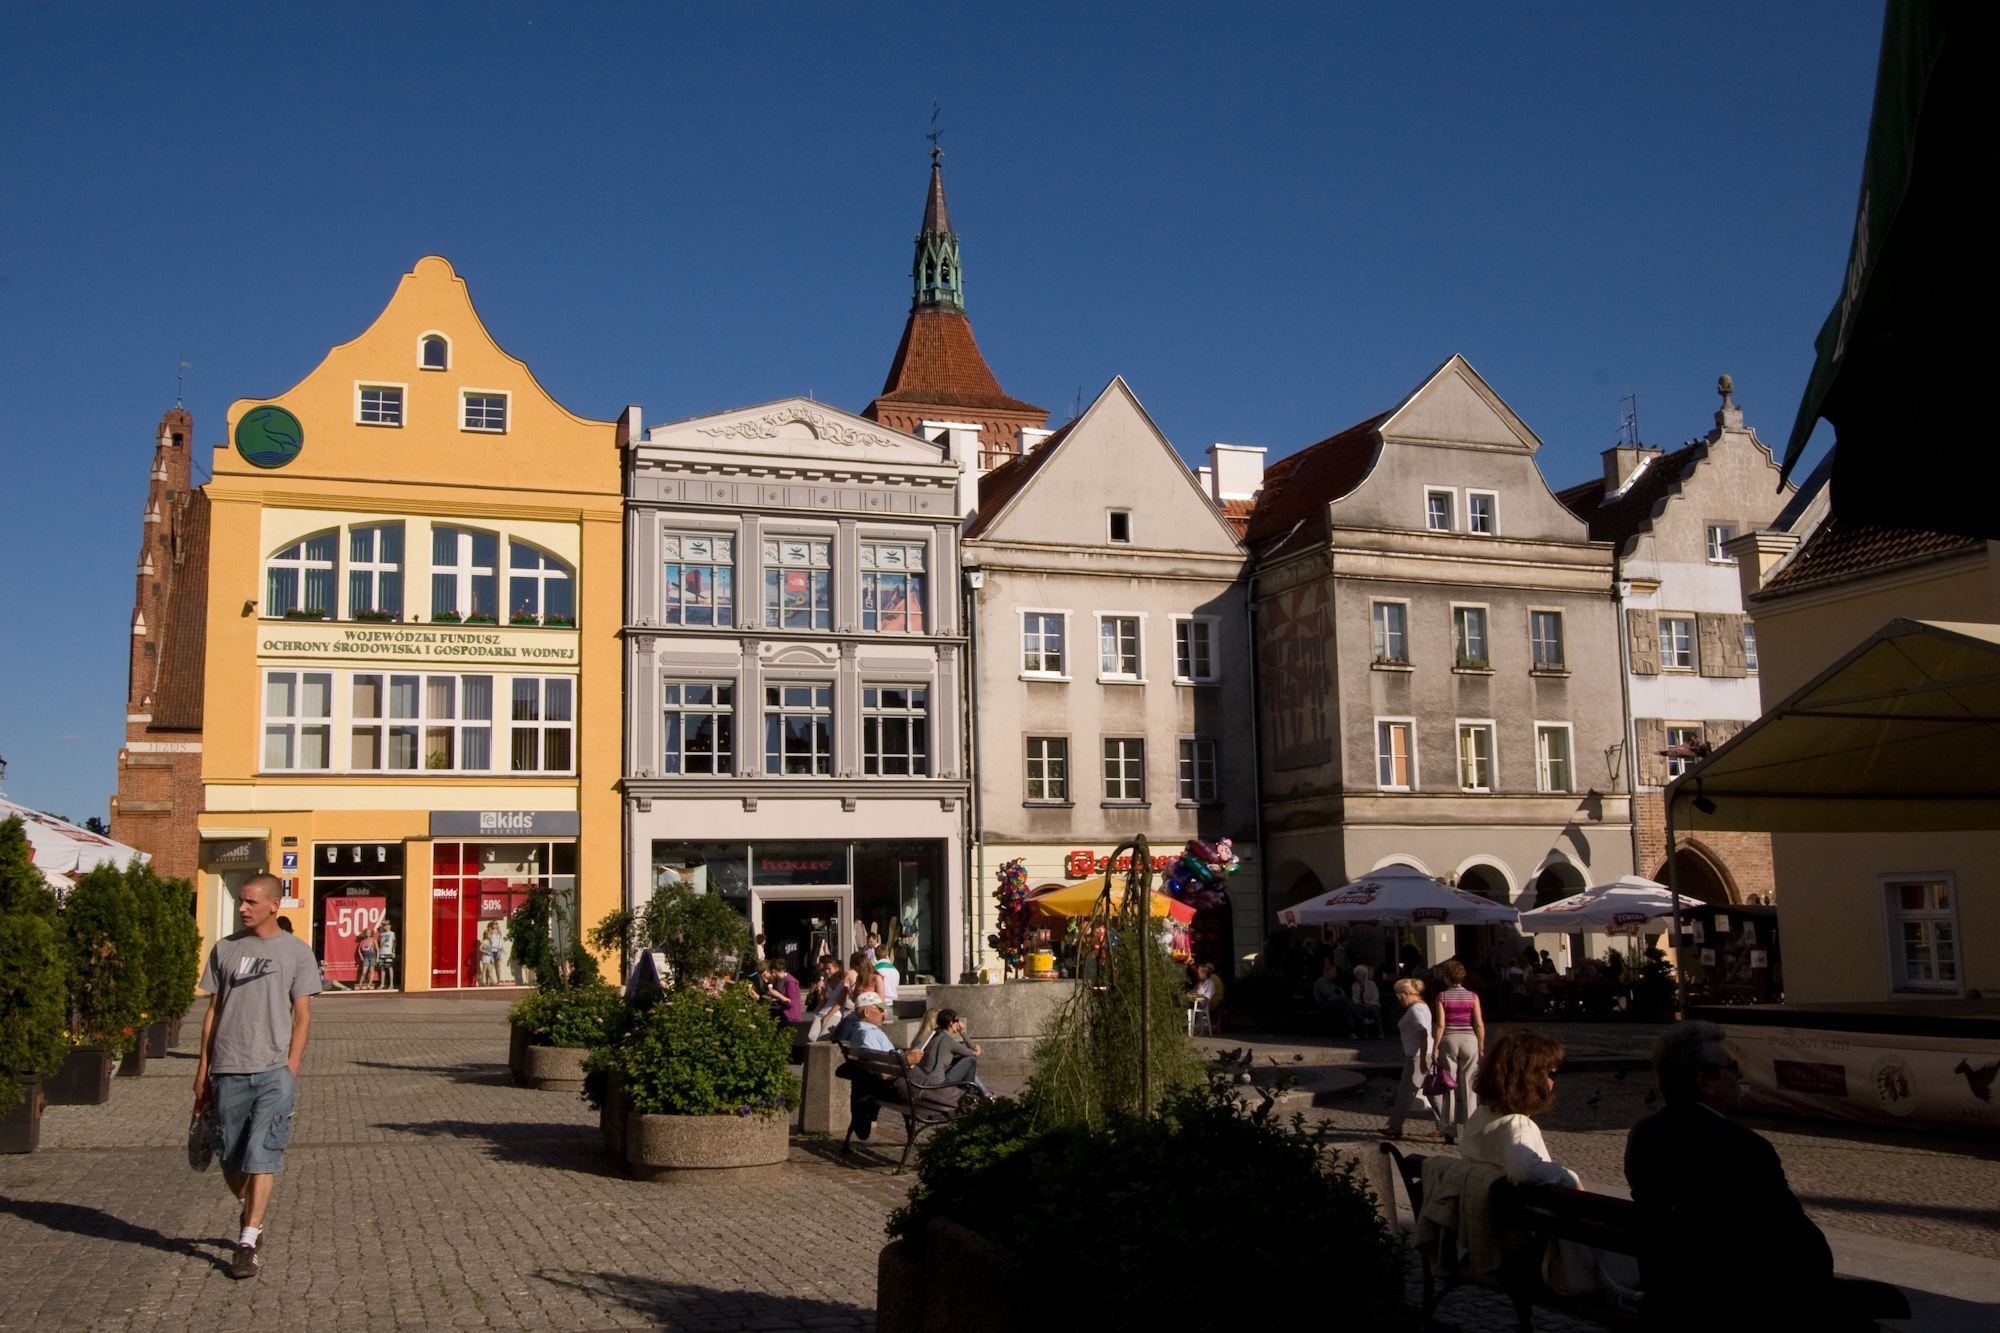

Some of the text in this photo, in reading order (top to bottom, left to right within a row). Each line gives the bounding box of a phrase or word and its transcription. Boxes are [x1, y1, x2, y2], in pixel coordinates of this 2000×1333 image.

[345, 630, 500, 645] WOJEWÓDZKI FUNDUSZ
[263, 640, 575, 659] OCHRONY ŚRODOWISKA I GOSPODARKI WODNEJ
[286, 856, 294, 866] 7
[481, 900, 501, 910] -50%
[239, 957, 272, 974] NIKE
